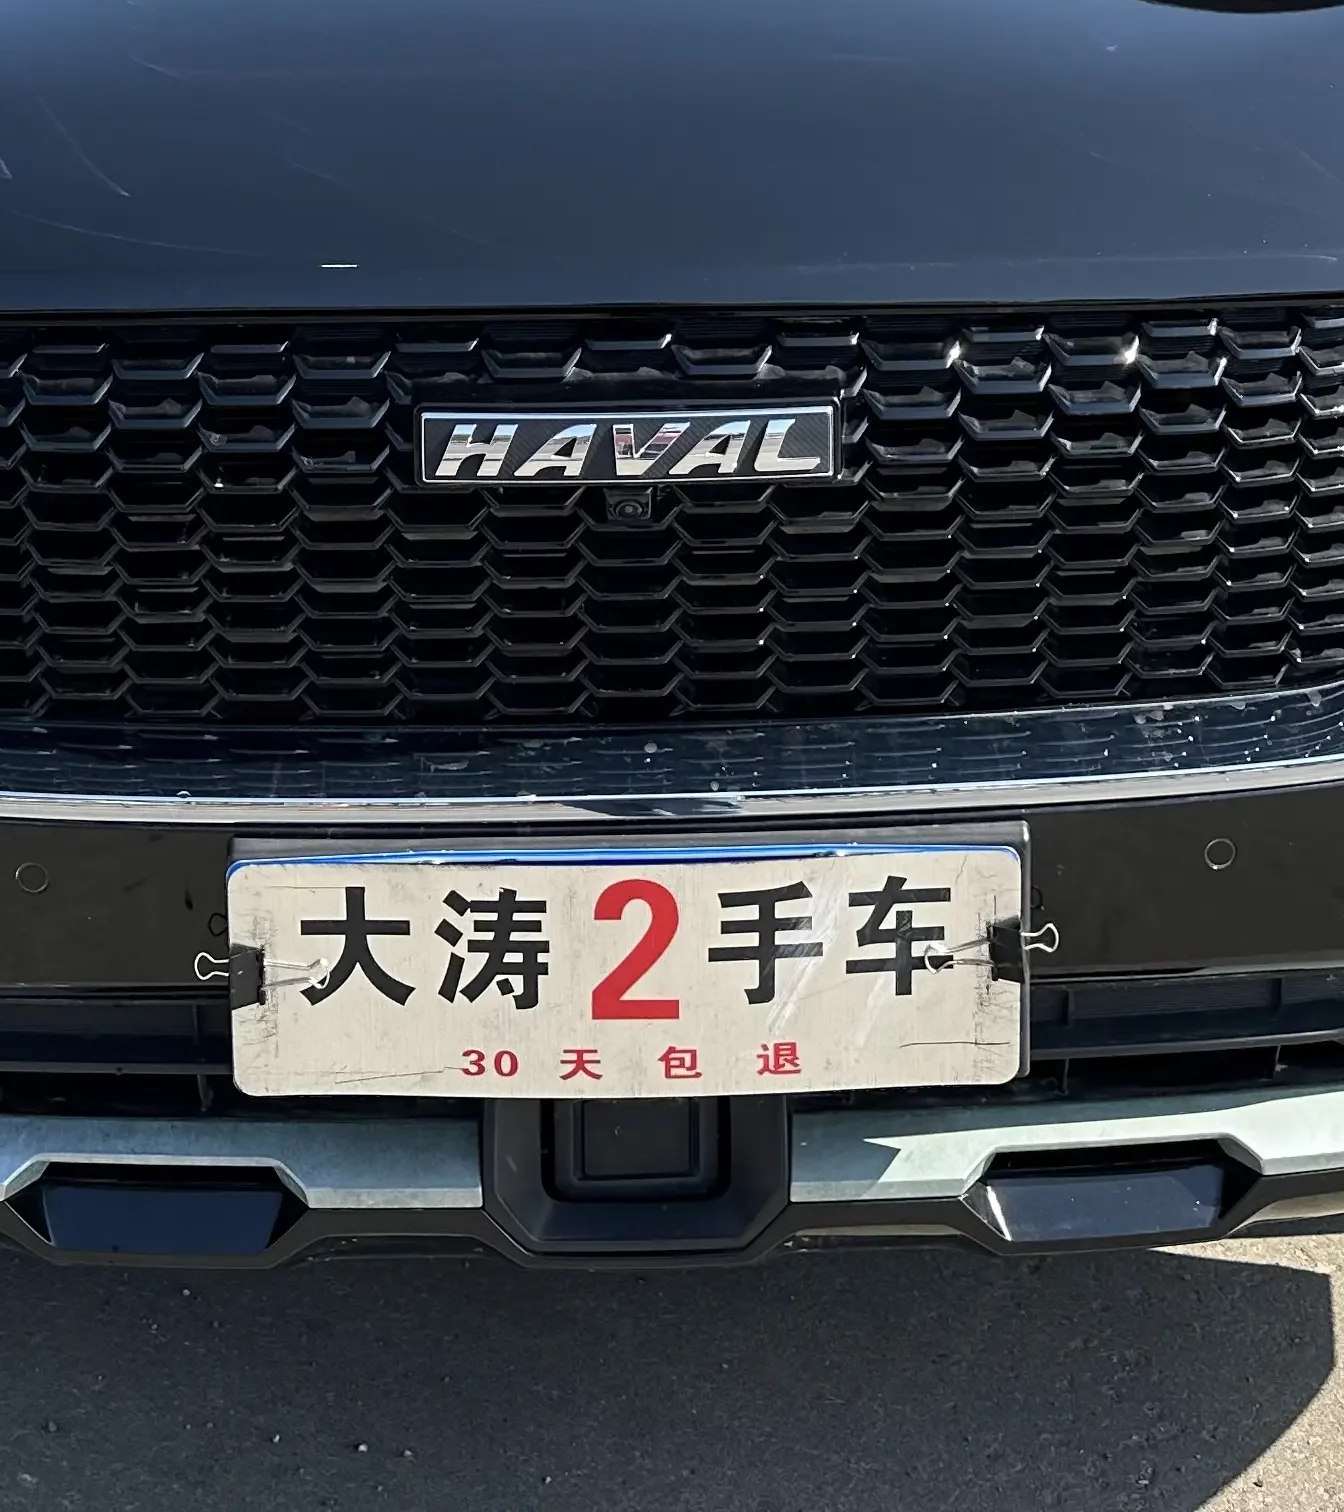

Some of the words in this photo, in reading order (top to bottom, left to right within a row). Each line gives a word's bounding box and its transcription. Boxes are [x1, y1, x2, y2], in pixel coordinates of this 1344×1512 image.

[435, 418, 822, 479] HAVAL
[299, 877, 956, 1021] 大涛2手车
